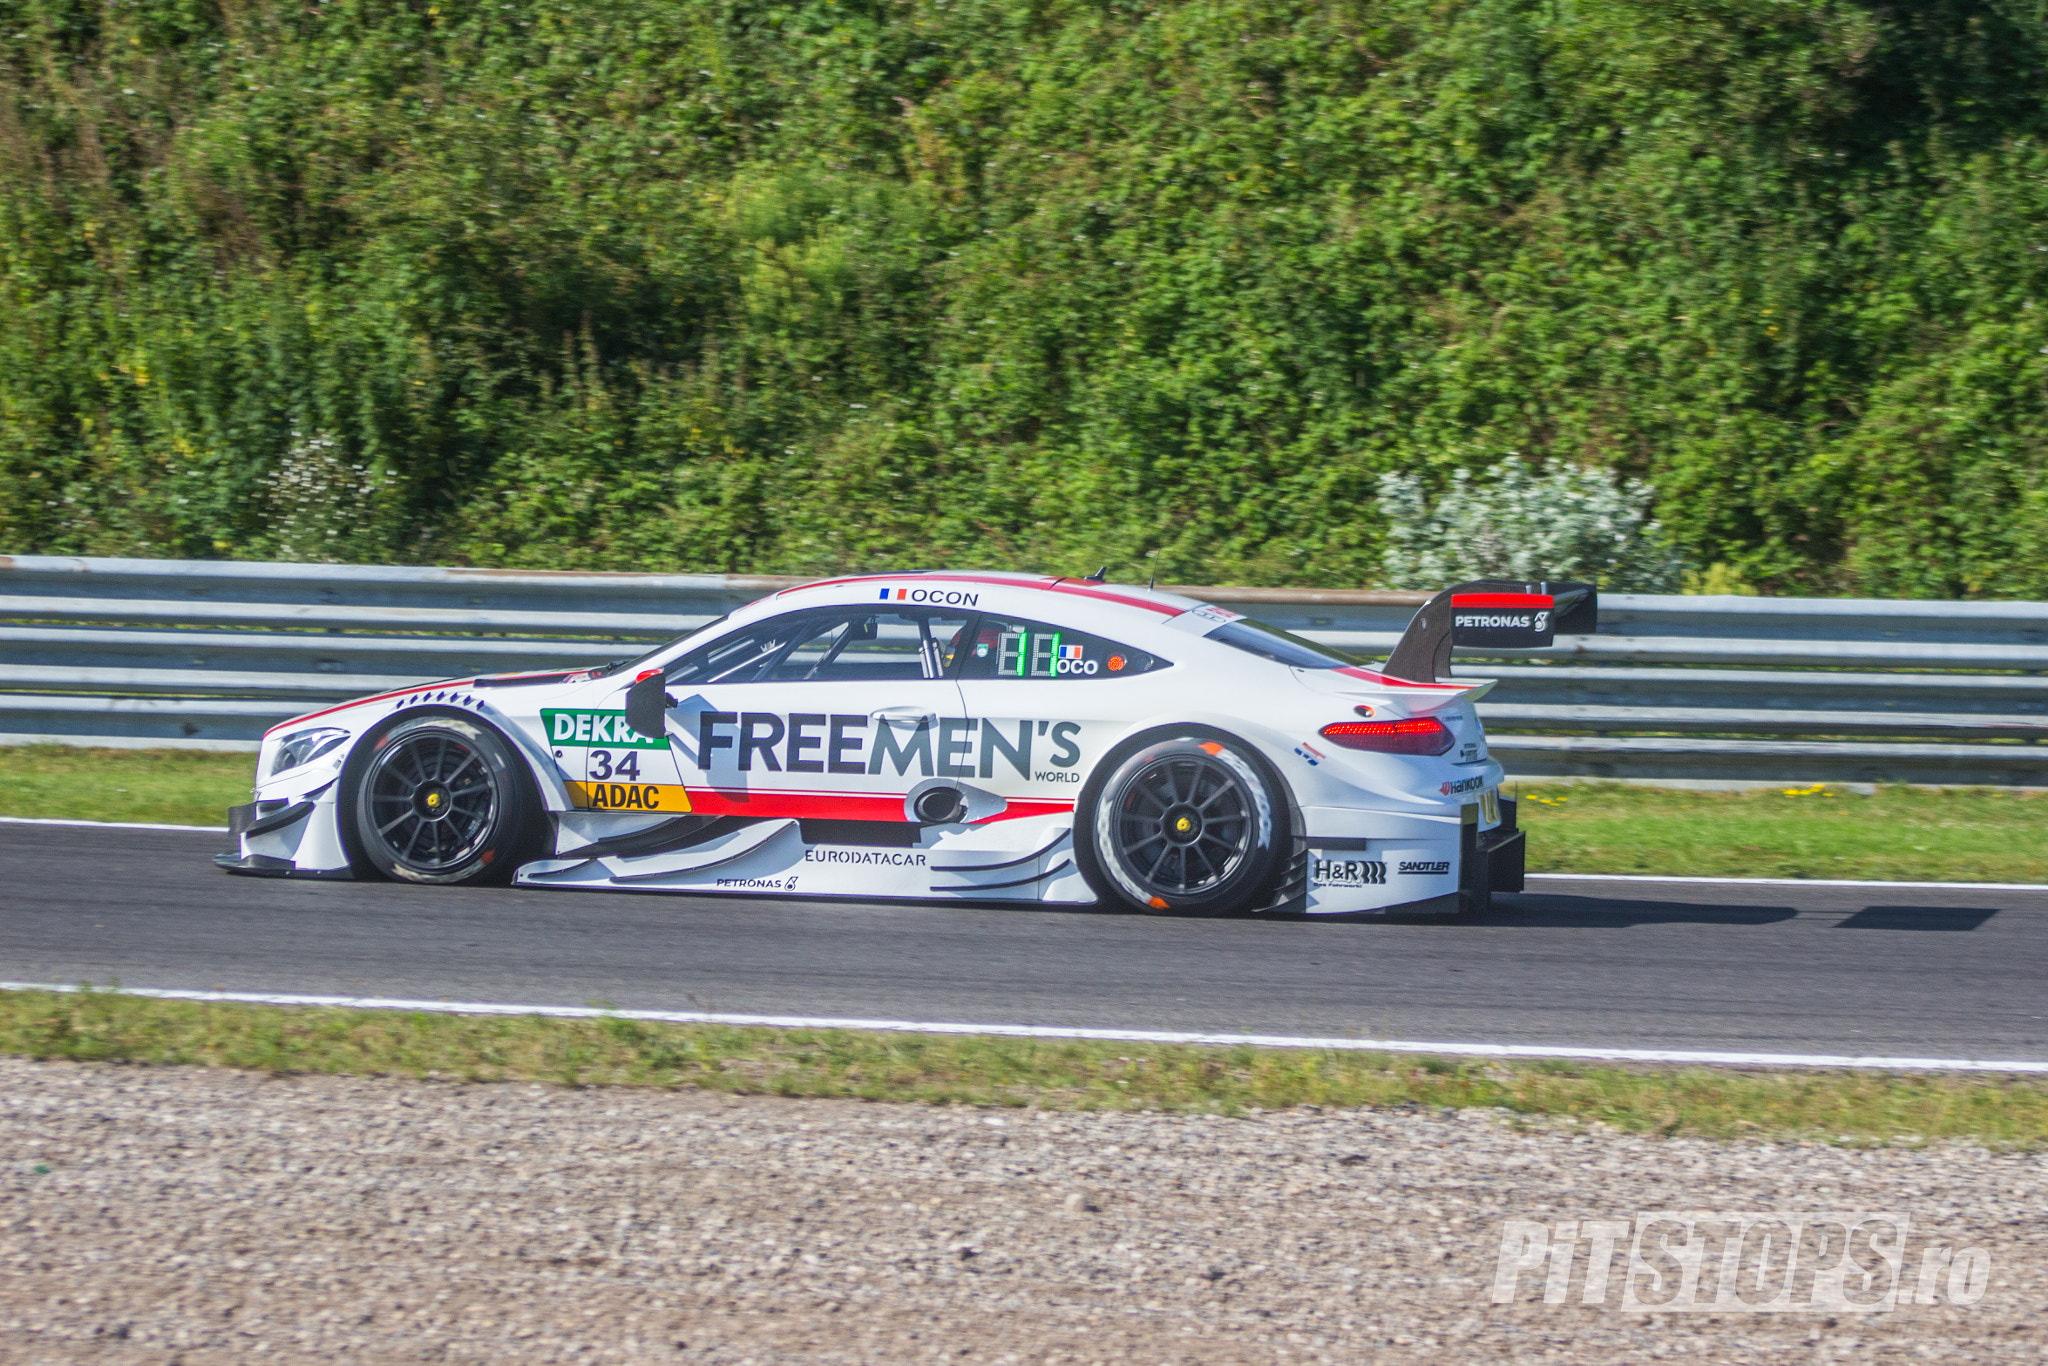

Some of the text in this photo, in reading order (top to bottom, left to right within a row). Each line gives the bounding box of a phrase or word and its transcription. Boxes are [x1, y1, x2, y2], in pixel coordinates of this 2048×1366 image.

[911, 588, 979, 606] OCON
[1455, 616, 1530, 627] PETRONAS
[1056, 659, 1098, 675] OCO
[698, 711, 1082, 781] FREEMEN'S
[588, 750, 640, 781] 34
[1034, 771, 1080, 783] WORLD
[592, 784, 659, 809] ADAC
[805, 850, 926, 866] EURODATACAR
[1398, 861, 1450, 872] SANDTLER
[716, 878, 782, 888] PETRONAS
